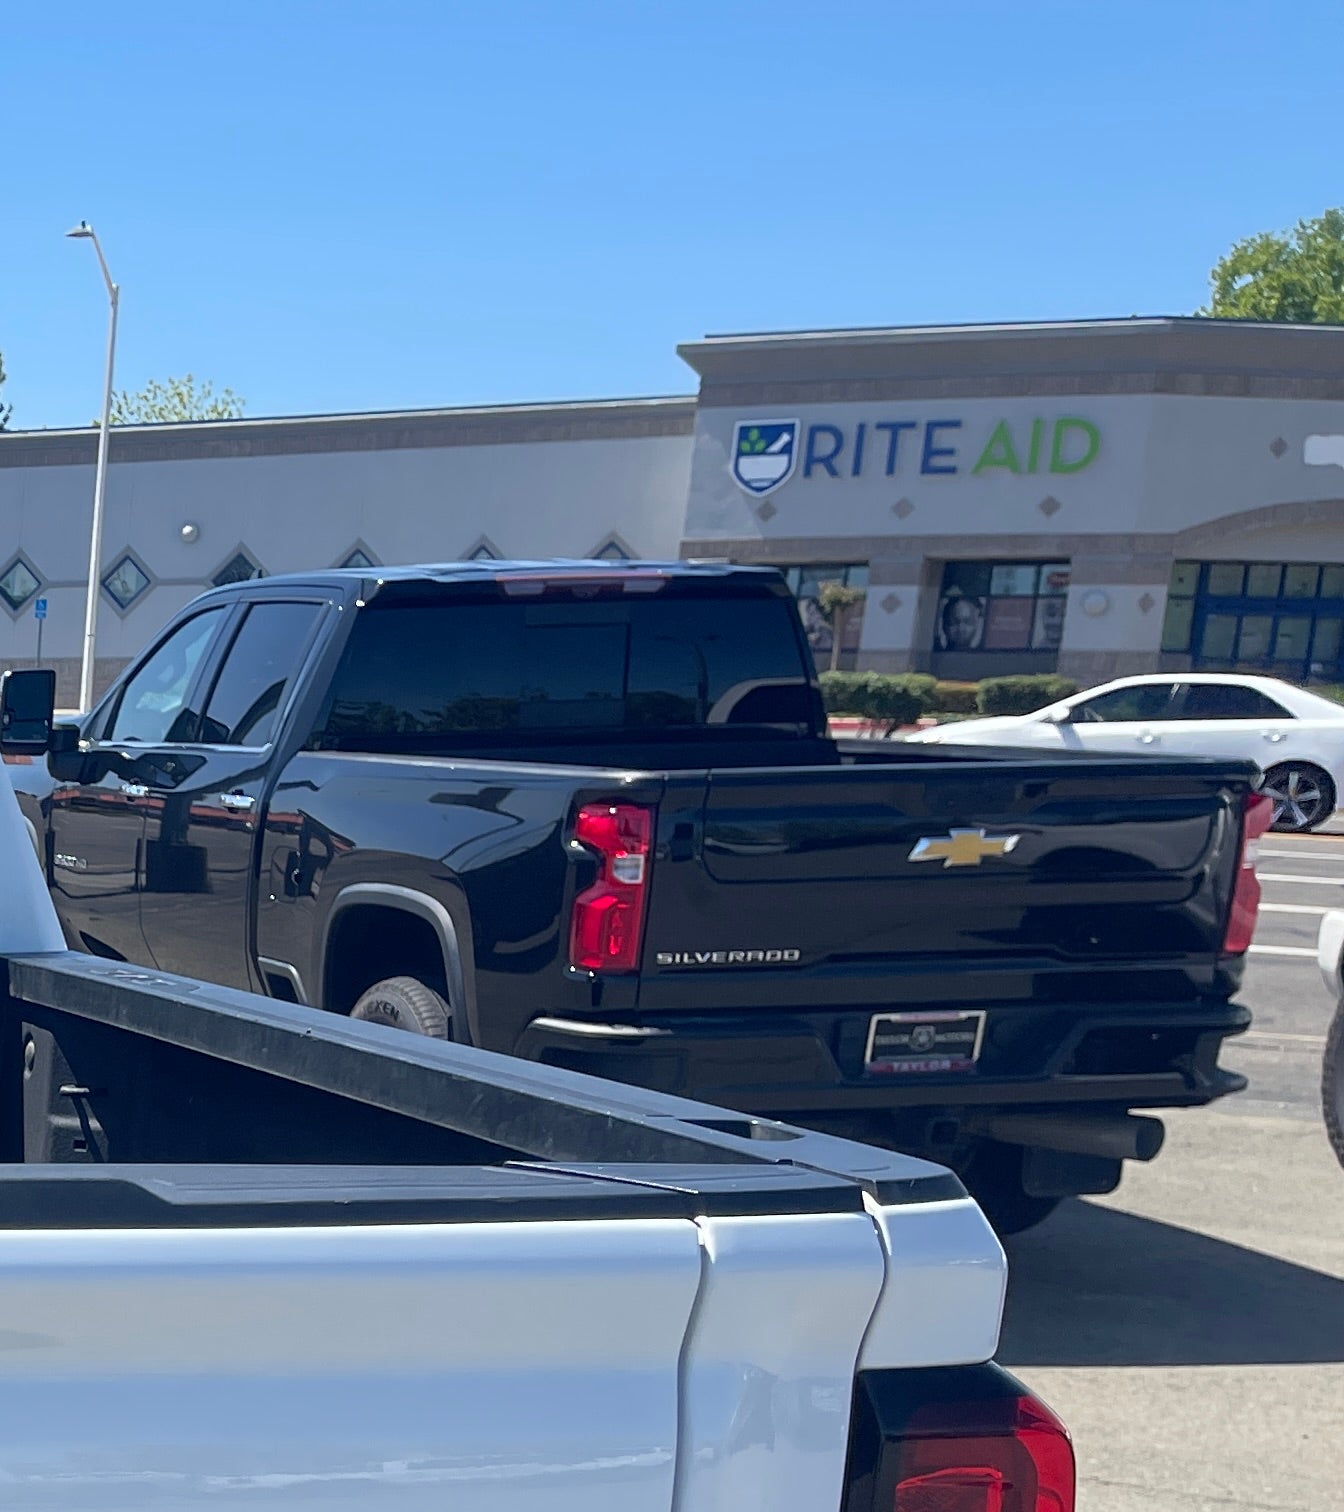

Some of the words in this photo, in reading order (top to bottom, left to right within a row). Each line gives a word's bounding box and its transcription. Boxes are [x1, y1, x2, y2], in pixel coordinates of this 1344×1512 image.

[802, 419, 963, 479] RITE
[971, 416, 1101, 475] AID
[656, 949, 801, 966] SILVERADO
